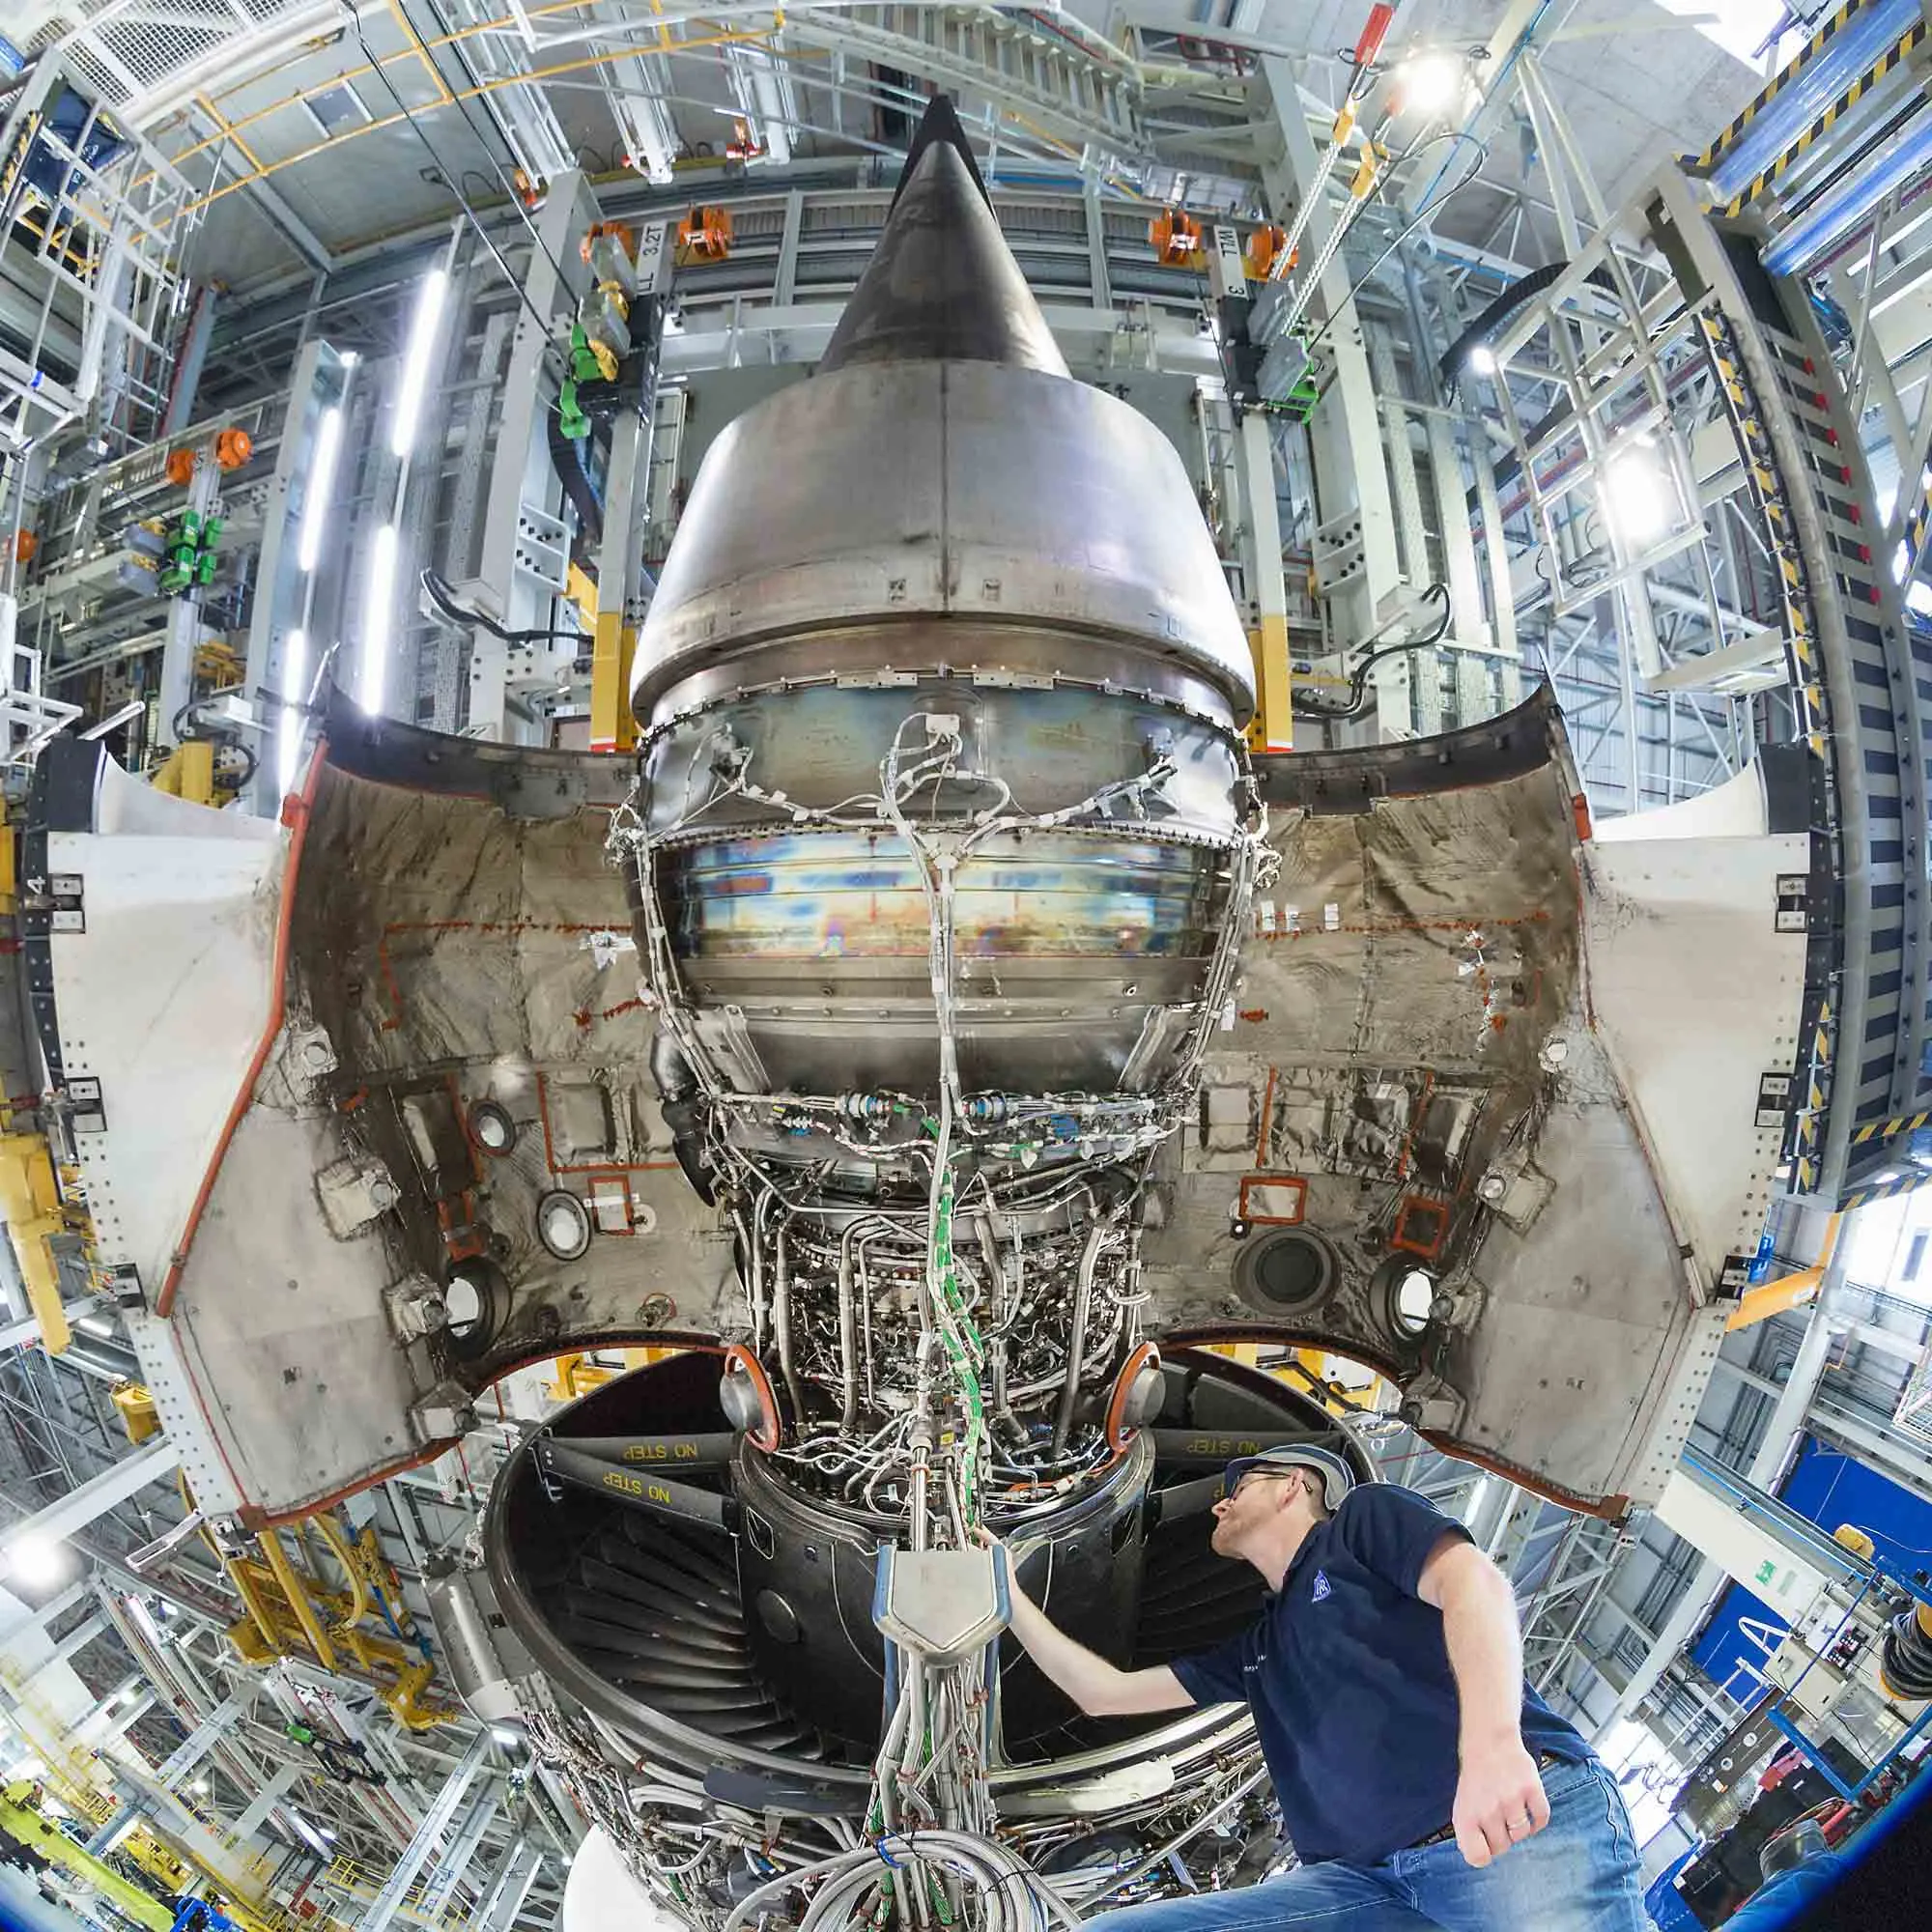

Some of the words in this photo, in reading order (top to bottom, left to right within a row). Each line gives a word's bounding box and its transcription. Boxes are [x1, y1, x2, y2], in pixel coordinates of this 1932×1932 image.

[642, 226, 663, 256] 3.2T
[1218, 231, 1237, 258] WLL
[638, 272, 654, 292] LL
[623, 1444, 667, 1460] STEP
[673, 1443, 698, 1459] NO
[1187, 1439, 1230, 1453] STEP
[1237, 1440, 1262, 1454] NO
[603, 1471, 642, 1494] STEP
[648, 1486, 671, 1503] NO
